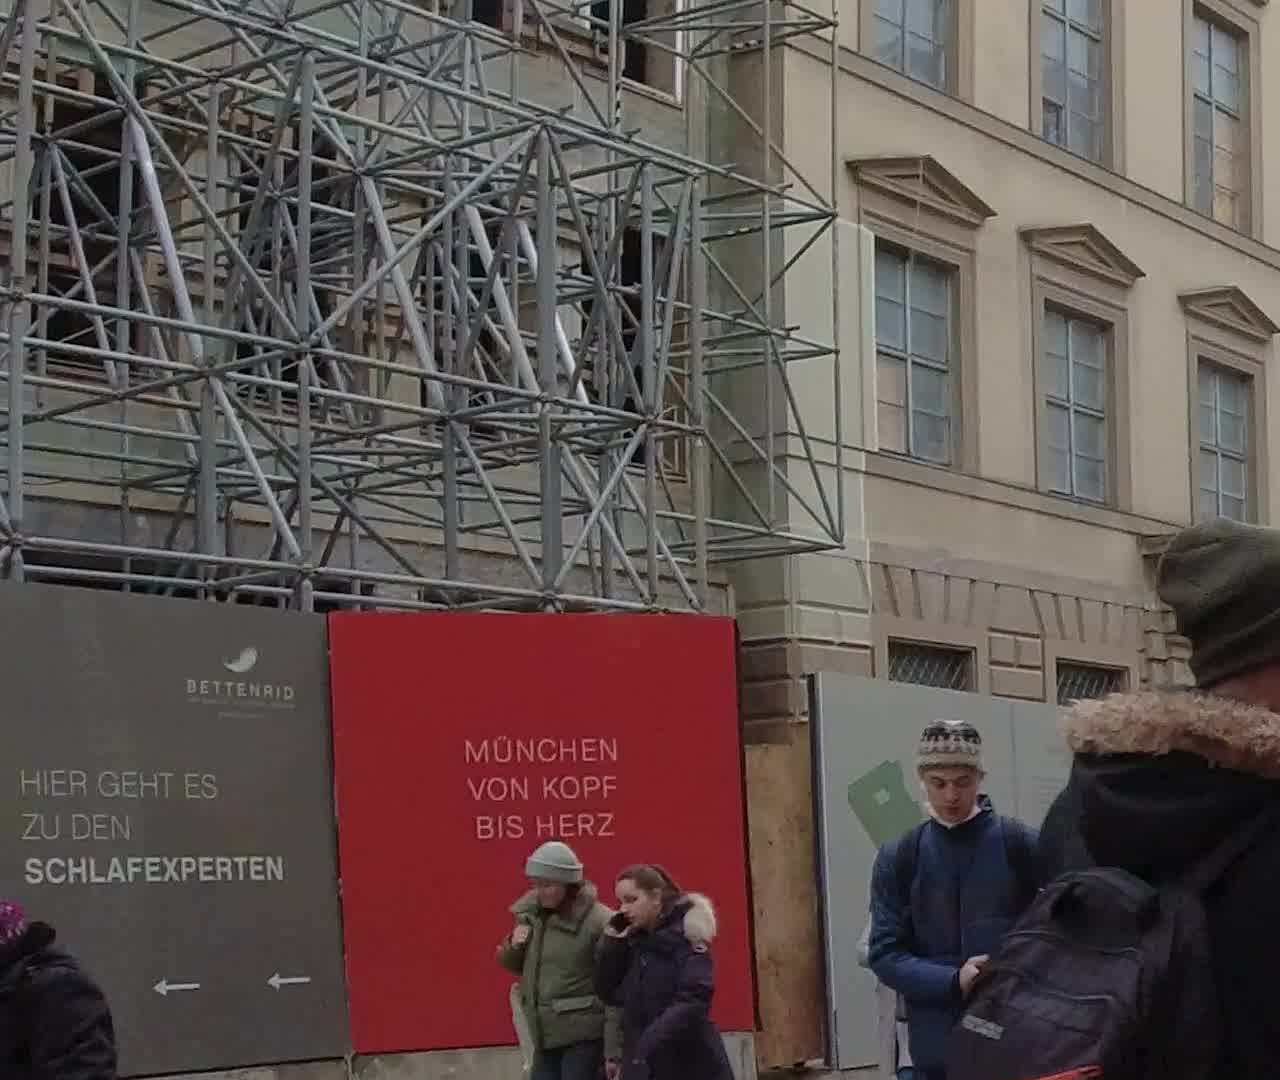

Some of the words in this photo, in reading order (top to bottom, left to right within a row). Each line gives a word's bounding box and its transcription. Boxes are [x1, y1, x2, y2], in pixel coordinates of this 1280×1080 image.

[186, 679, 295, 701] BETTENRID
[464, 735, 618, 764] MÜNCHEN
[20, 768, 88, 797] HIER
[97, 771, 175, 799] GEHT
[183, 773, 218, 799] ES
[466, 776, 529, 801] VON
[542, 775, 618, 800] KOPF
[21, 813, 61, 840] ZU
[71, 813, 132, 841] DEN
[475, 814, 525, 840] BIS
[535, 811, 616, 838] HERZ
[24, 855, 285, 885] SCHLAFEXPERTEN
